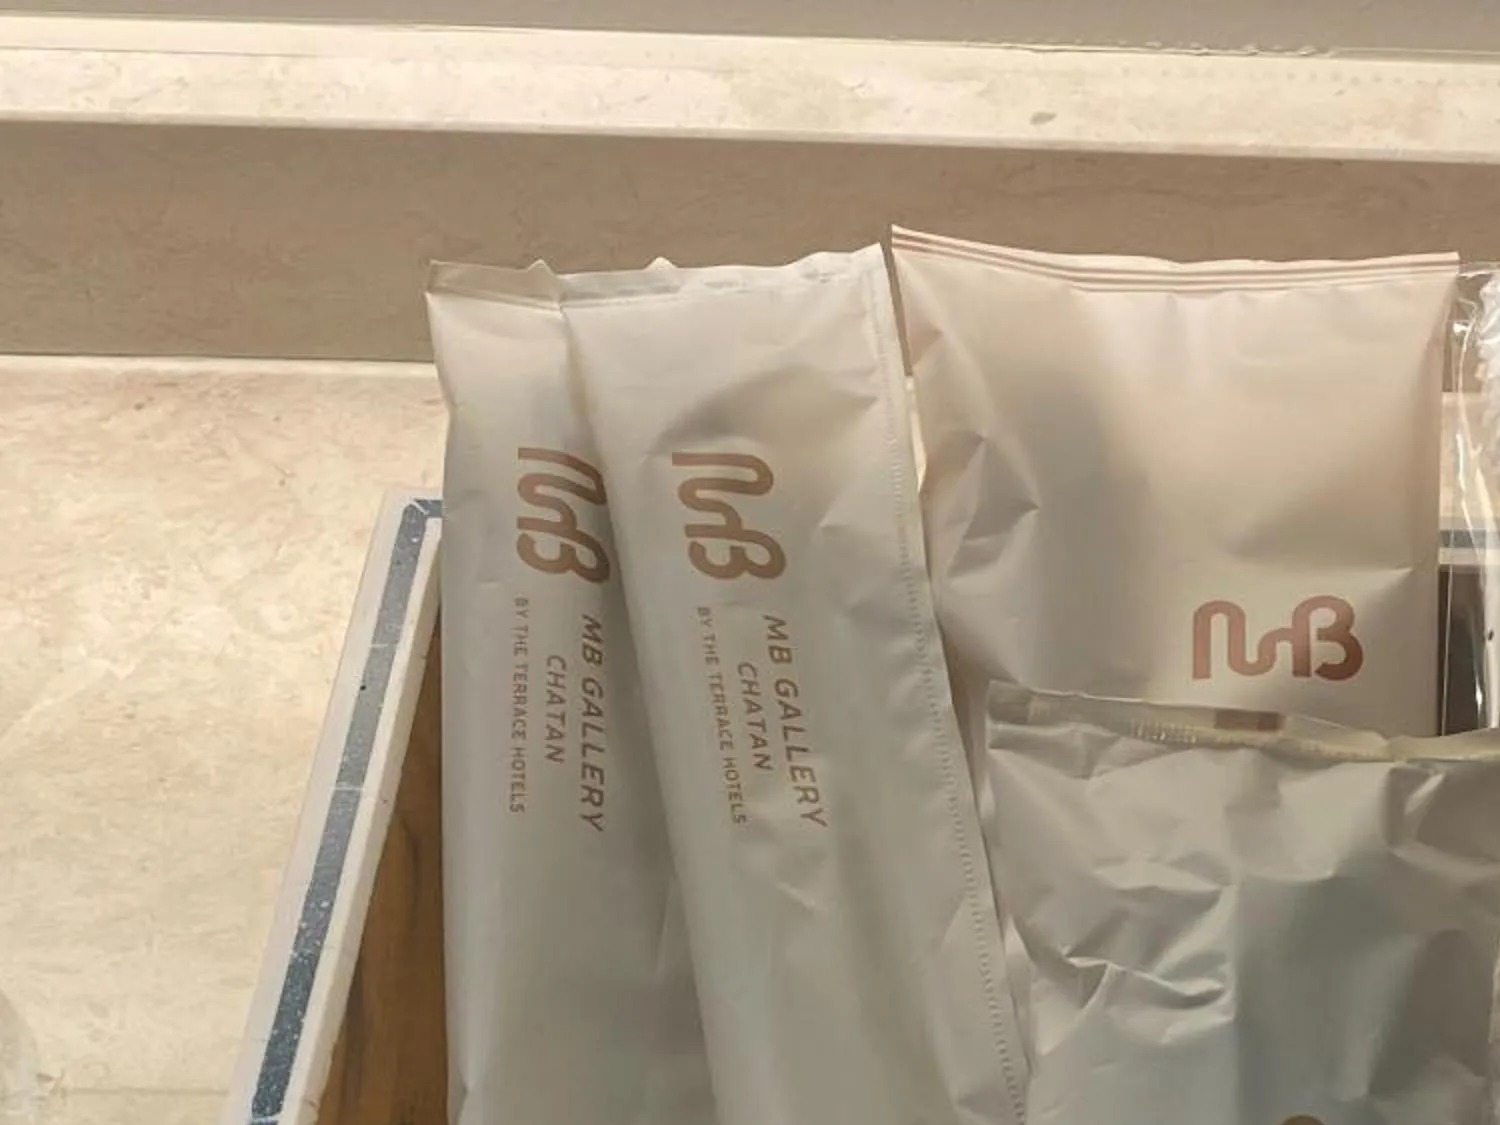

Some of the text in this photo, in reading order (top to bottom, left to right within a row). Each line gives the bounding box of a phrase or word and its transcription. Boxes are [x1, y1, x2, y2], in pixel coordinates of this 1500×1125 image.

[512, 625, 529, 657] THE
[512, 664, 529, 740] TERRACE
[545, 655, 567, 764] CHATAN
[580, 613, 606, 832] MB GALLERY
[698, 607, 747, 824] BY THE TERRACE HOTELS
[738, 662, 774, 770] CHATAN
[762, 614, 828, 827] MB GALLERY
[509, 747, 528, 814] HOTELS
